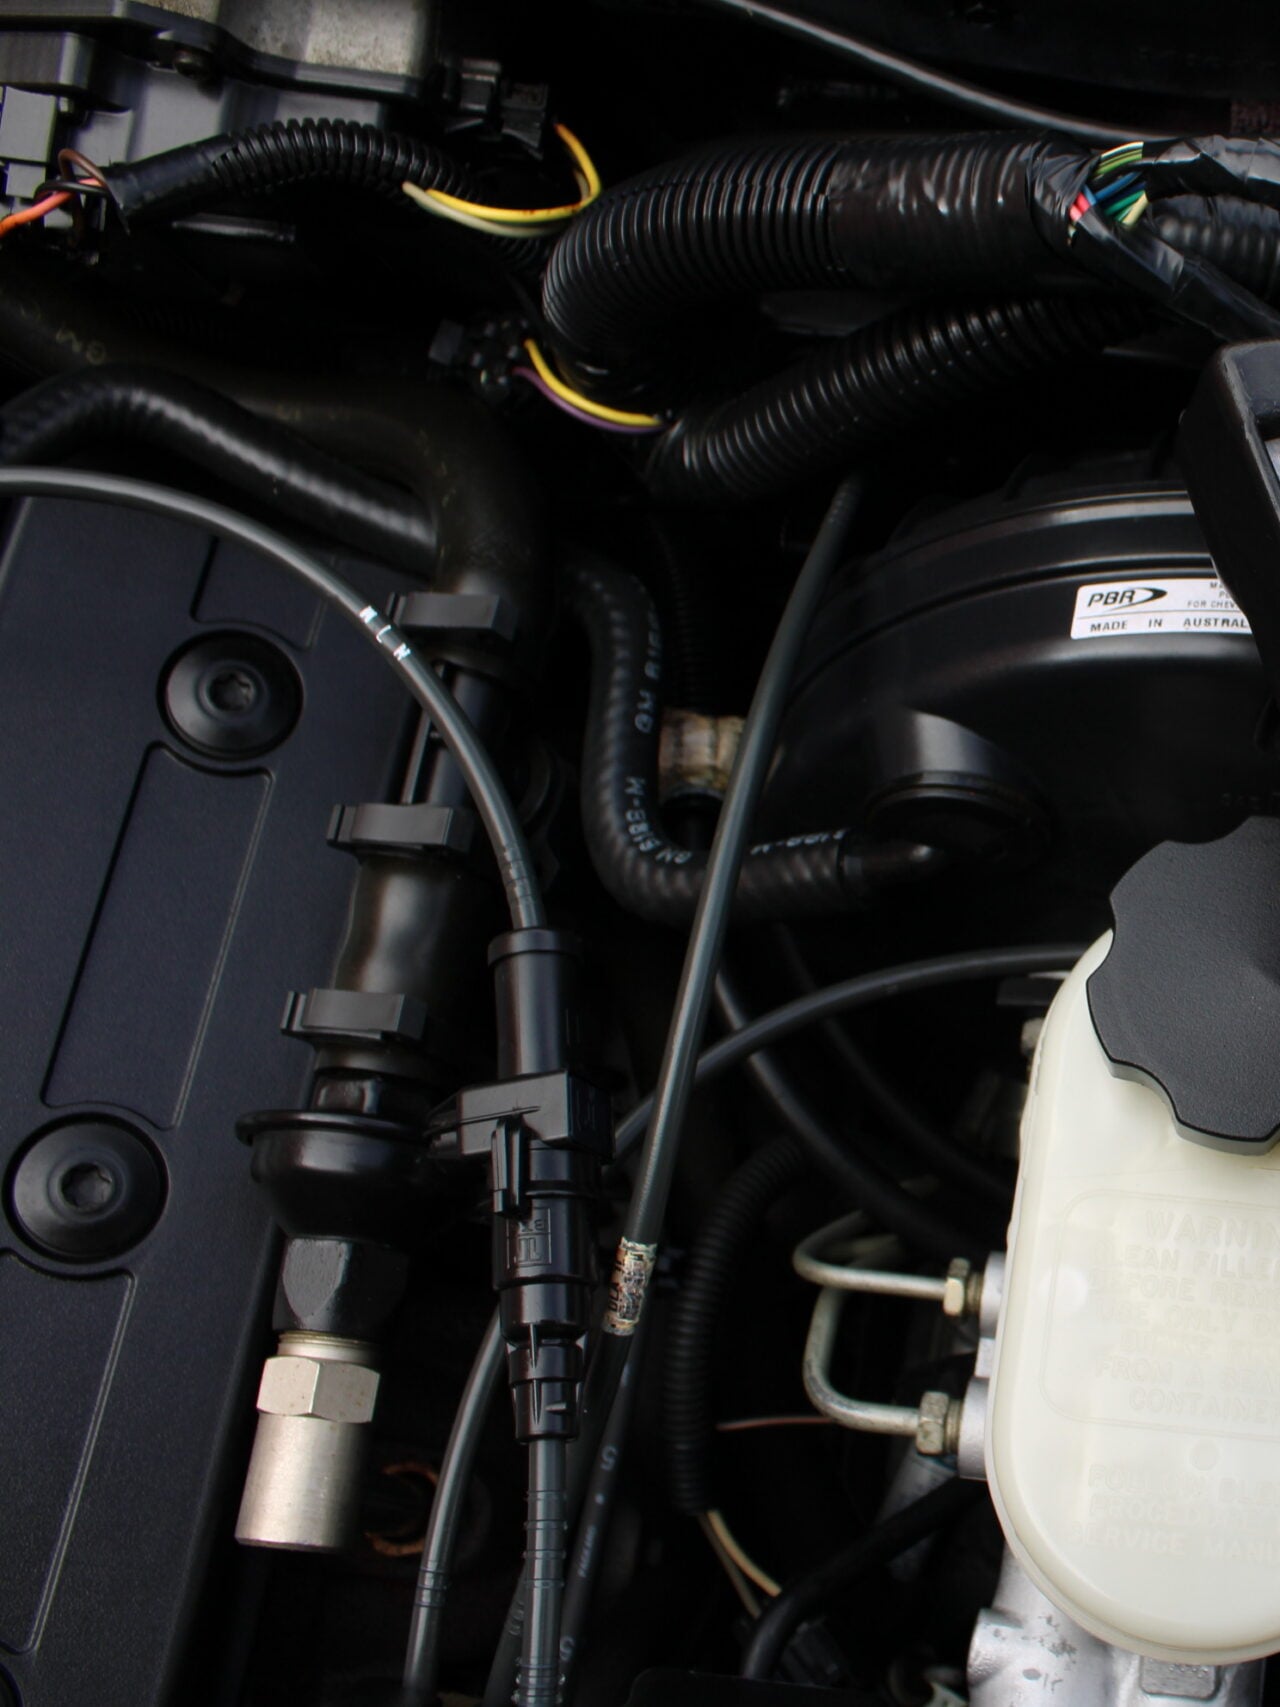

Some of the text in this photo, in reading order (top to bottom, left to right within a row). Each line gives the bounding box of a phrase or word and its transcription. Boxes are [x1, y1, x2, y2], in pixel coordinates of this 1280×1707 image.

[1087, 588, 1137, 607] PBR
[1090, 617, 1250, 632] MADE IN AUSTRAL
[1096, 1238, 1180, 1272] CLEAN
[1087, 1266, 1197, 1302] BEFORE
[1098, 1299, 1149, 1327] USE
[1164, 1304, 1239, 1334] ONLY
[1095, 1354, 1173, 1386] FROM
[1184, 1362, 1206, 1389] A
[1088, 1463, 1207, 1499] FOLLOW
[1065, 1520, 1187, 1557] SERVICE
